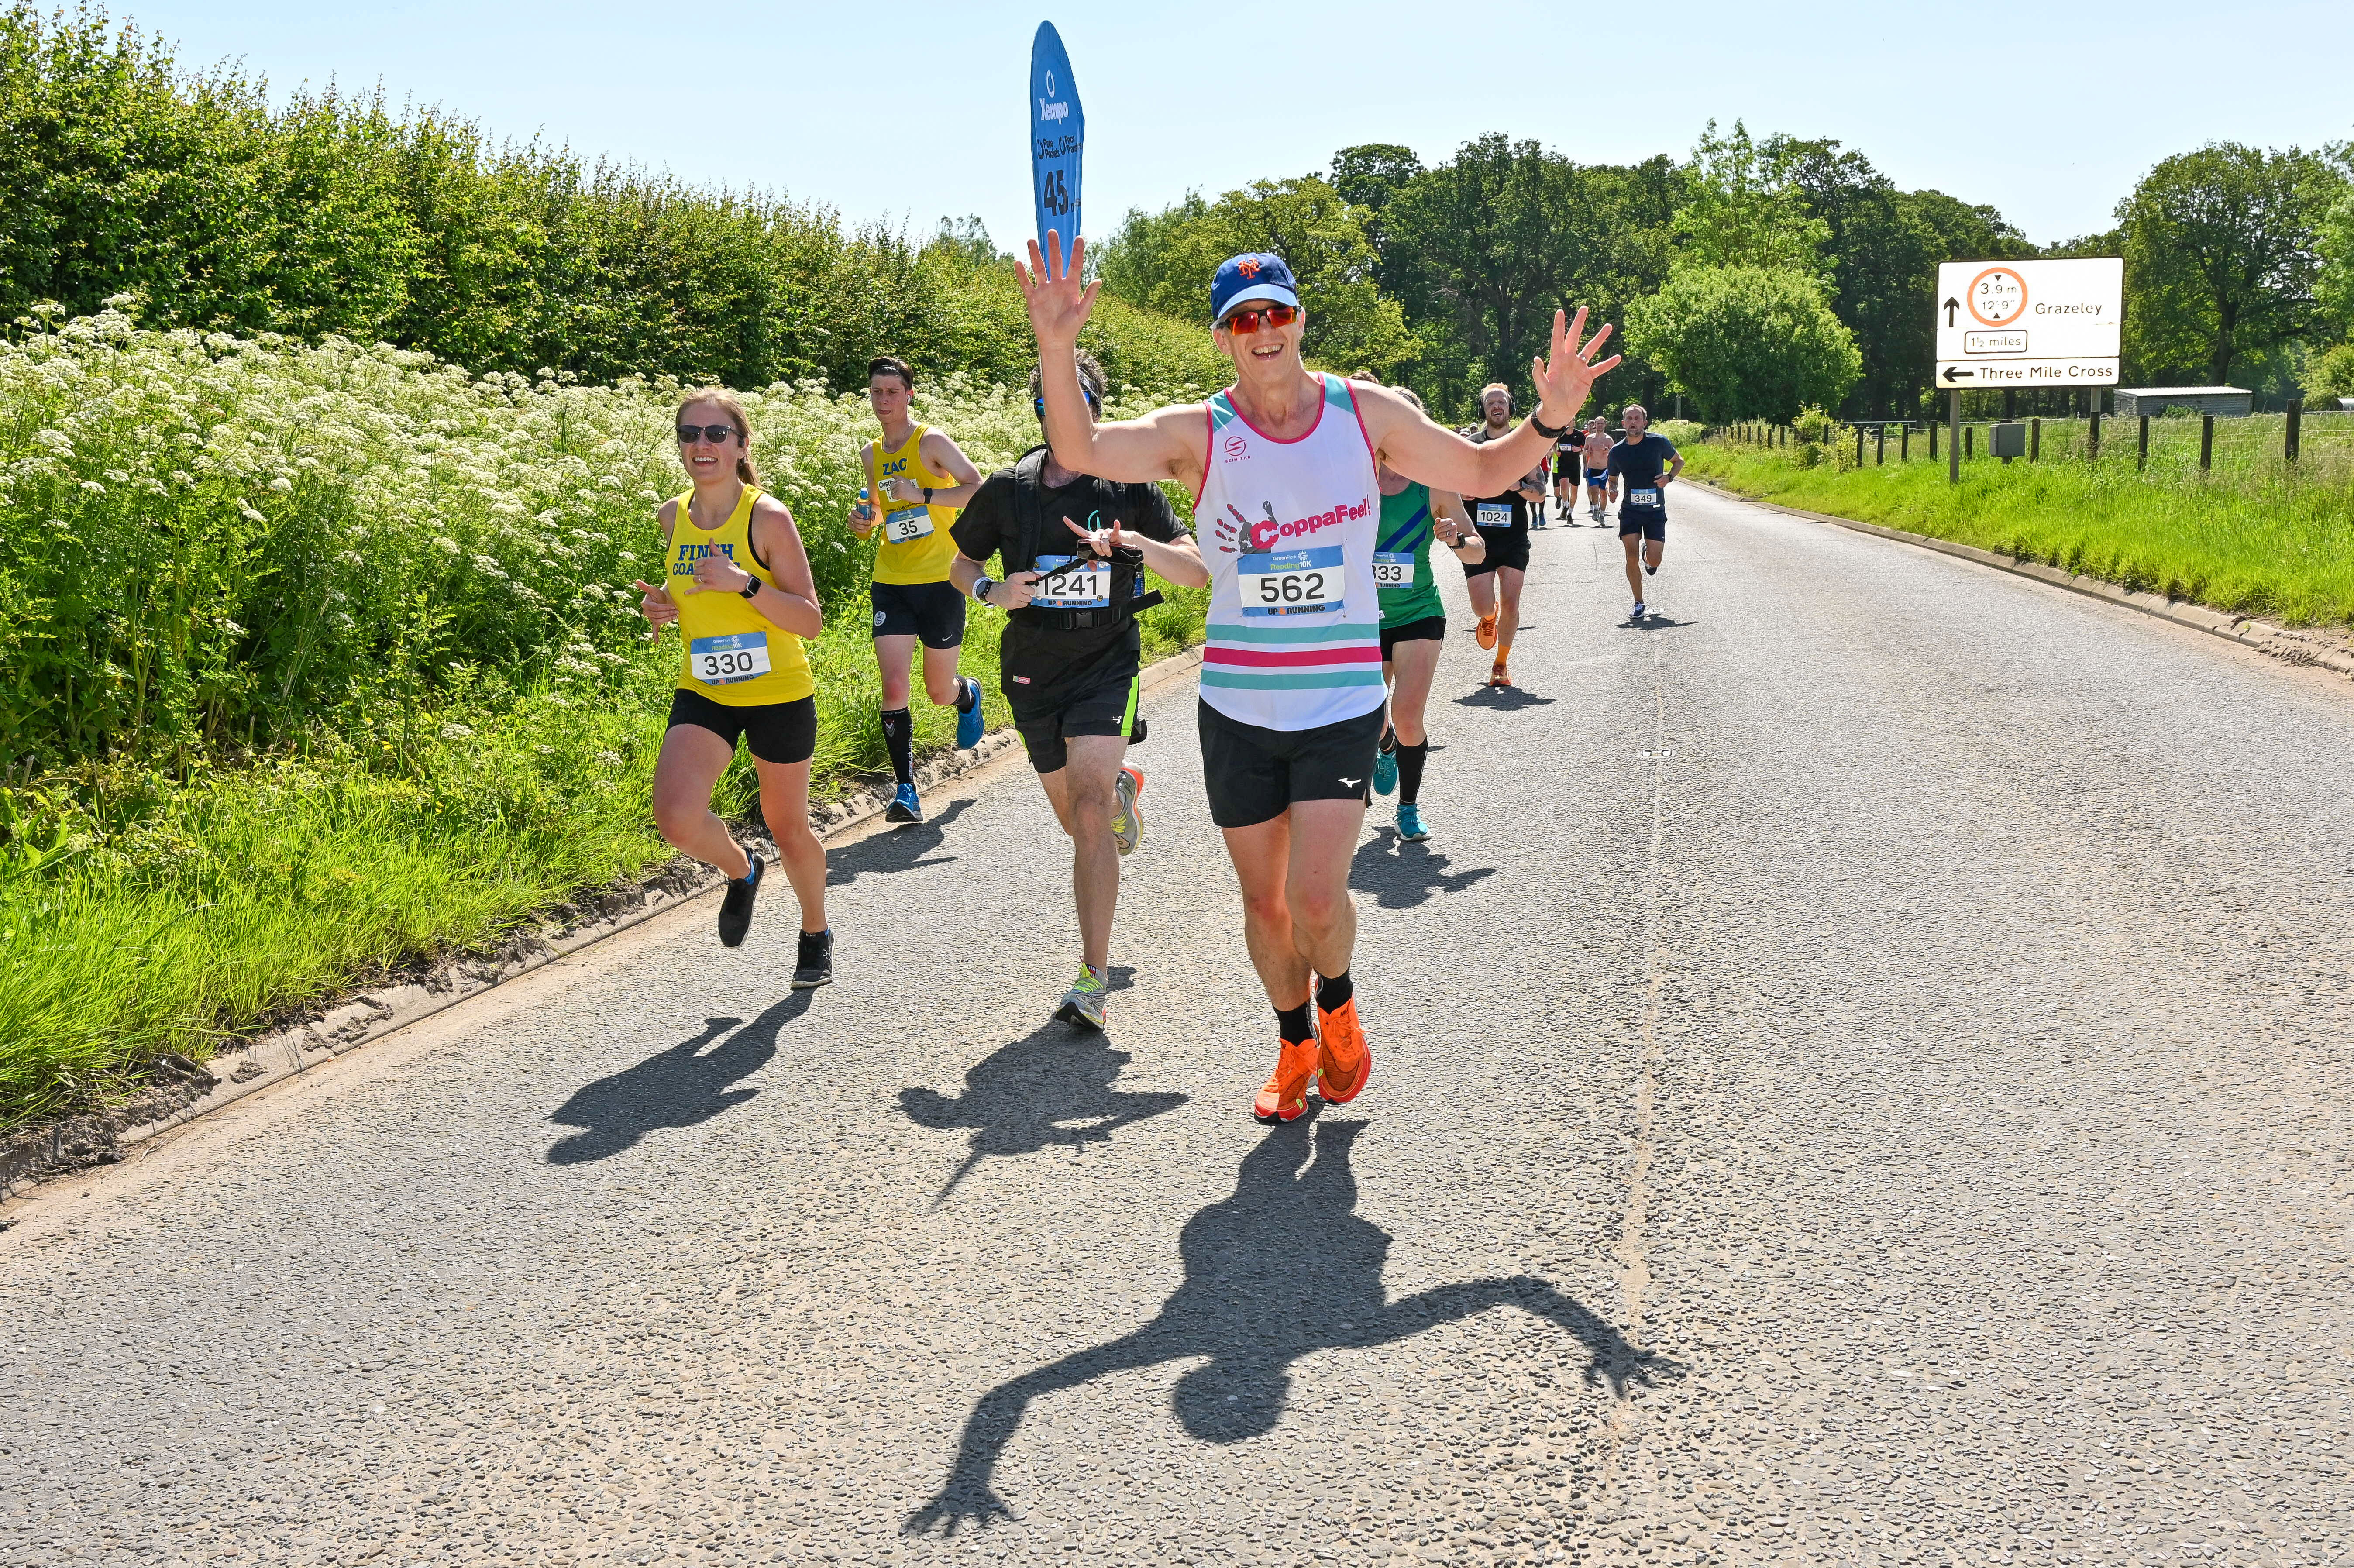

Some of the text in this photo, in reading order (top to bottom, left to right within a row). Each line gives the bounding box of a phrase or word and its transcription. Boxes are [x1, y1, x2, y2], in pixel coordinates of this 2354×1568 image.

[1039, 98, 1068, 125] Xempo
[1044, 170, 1068, 217] 45
[1981, 283, 2002, 294] 3.9
[2036, 303, 2102, 315] Grazeley
[1989, 336, 2021, 346] miles
[1980, 366, 2112, 379] Three Mile Cross
[882, 458, 907, 476] ZAC
[879, 479, 895, 488] Cysti
[1250, 494, 1371, 550] CoppaFeel!
[1481, 512, 1508, 522] 1024
[898, 520, 918, 535] 35
[1042, 574, 1097, 596] 1241
[1260, 573, 1325, 602] 562
[1287, 604, 1325, 615] RUNNING
[704, 651, 753, 676] 330
[726, 674, 754, 684] RUNNING
